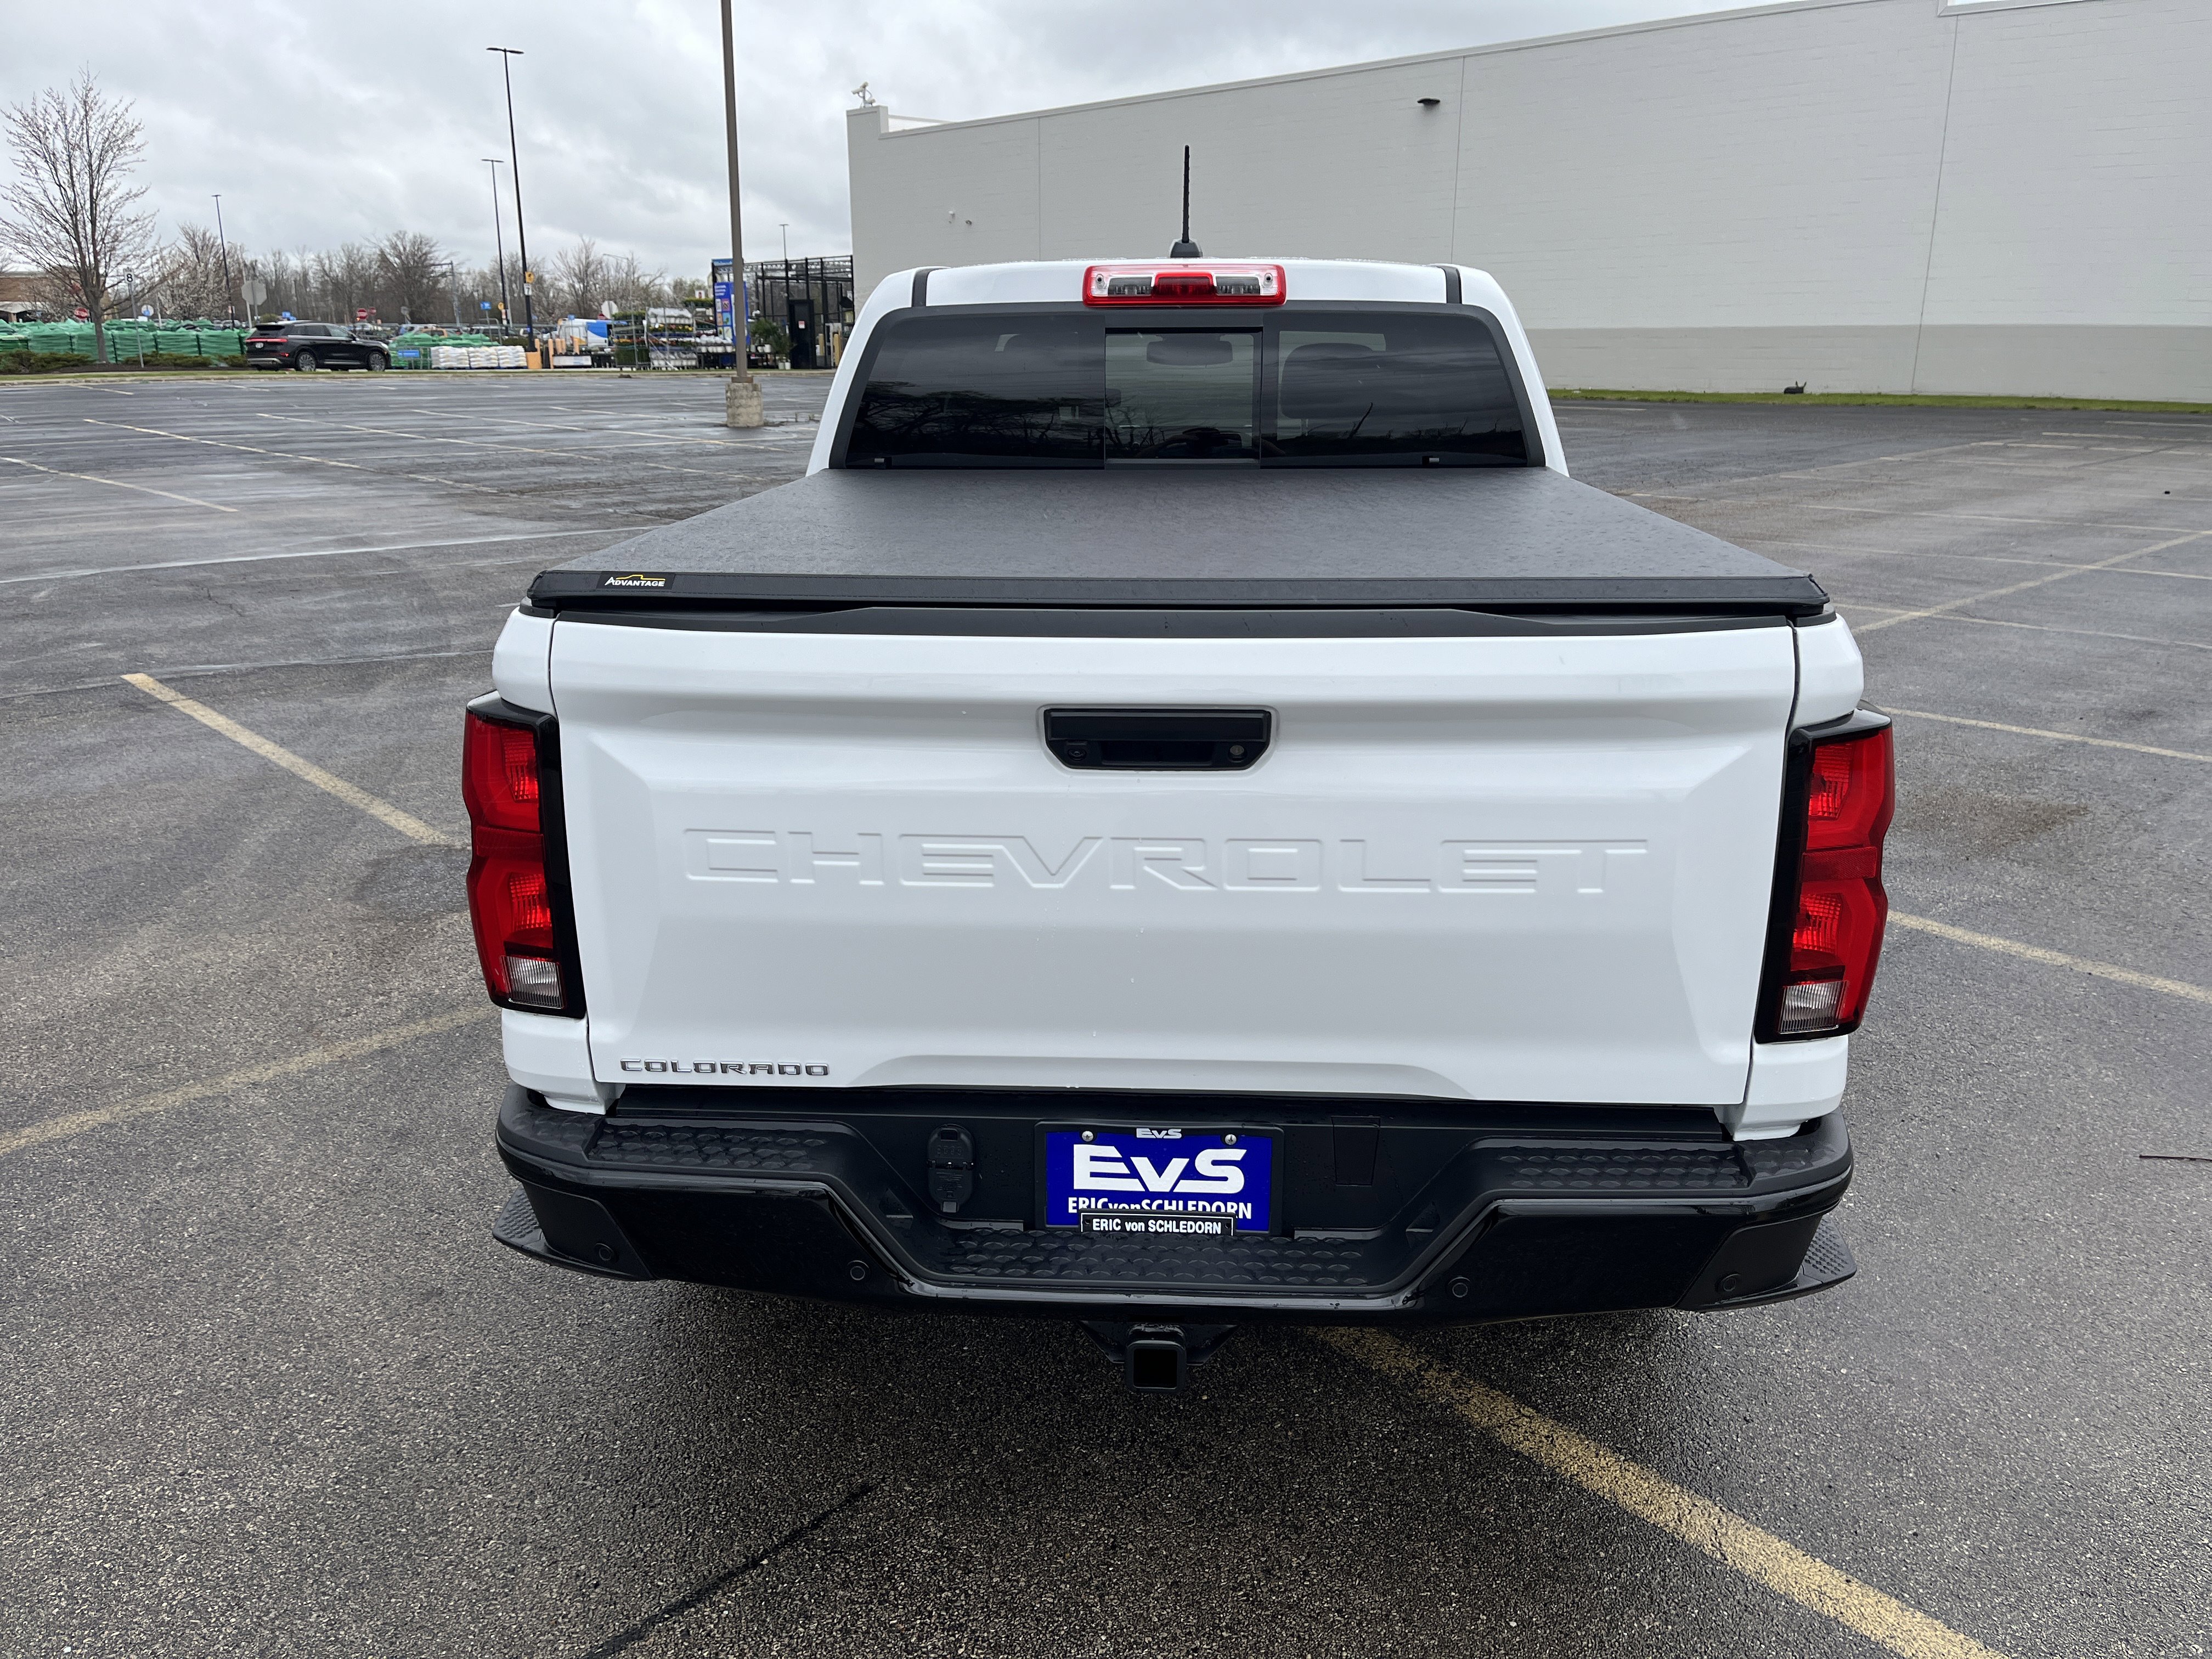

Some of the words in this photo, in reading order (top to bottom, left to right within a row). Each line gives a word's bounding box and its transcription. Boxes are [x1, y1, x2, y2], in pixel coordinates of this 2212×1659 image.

[126, 273, 133, 282] 8
[605, 577, 665, 586] ADVANTAGE
[684, 828, 1648, 894] CHEVROLET
[620, 1058, 829, 1076] COLORADO
[1092, 1218, 1121, 1231] ERIC
[1125, 1221, 1145, 1232] von
[1148, 1220, 1221, 1234] SCHLEDORN
